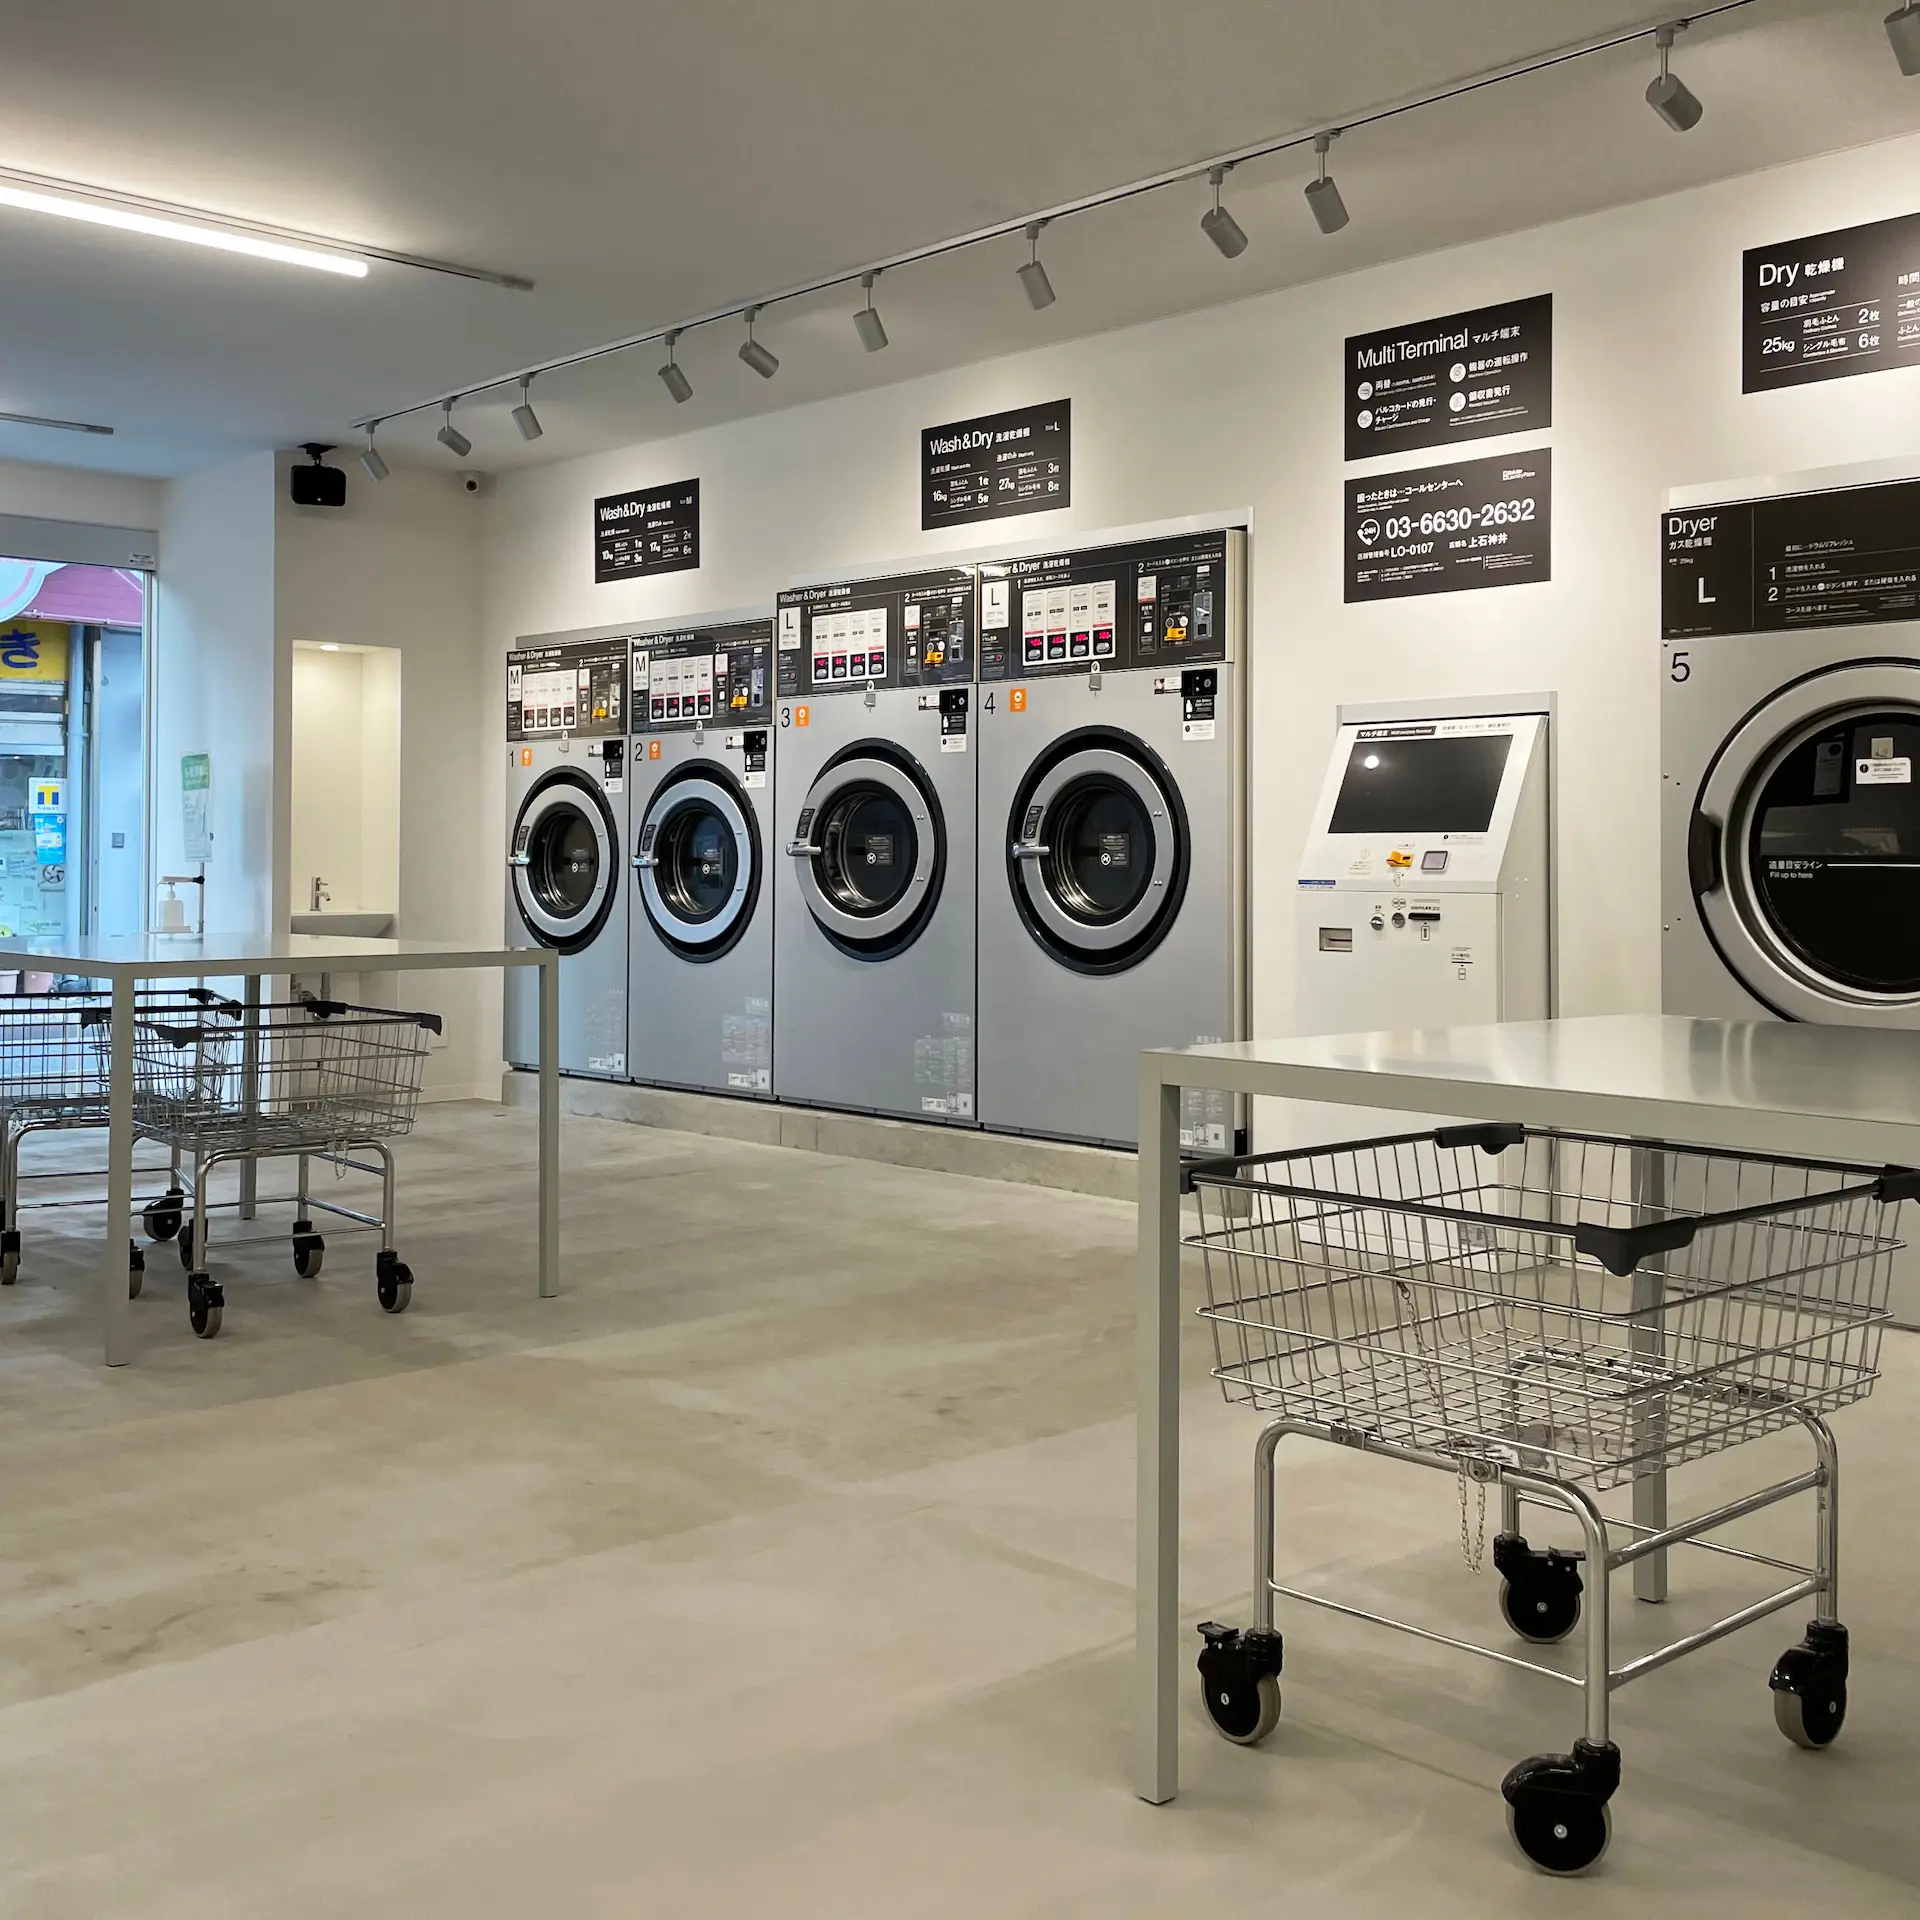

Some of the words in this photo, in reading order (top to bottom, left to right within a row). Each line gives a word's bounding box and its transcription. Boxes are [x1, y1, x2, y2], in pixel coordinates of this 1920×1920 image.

[1760, 263, 1800, 287] Dry
[1804, 257, 1845, 277] 乾燥機
[1760, 295, 1808, 313] 容量の目安
[1357, 348, 1396, 370] Multi
[1397, 328, 1468, 360] Terminal
[1472, 326, 1520, 344] マルチ端末
[1762, 336, 1795, 354] 25kg
[1468, 385, 1510, 402] 領収書発行
[1054, 422, 1060, 431] L
[1376, 412, 1399, 425] チャージ
[999, 478, 1015, 490] 27kg
[932, 490, 947, 502] 16kg
[1386, 498, 1536, 539] 03-6630-2632
[1668, 516, 1717, 537] Dryer
[1364, 527, 1376, 535] 24H
[1468, 532, 1508, 548] 上石神井
[1669, 536, 1712, 550] ガス乾燥機
[1391, 542, 1434, 558] LO-0107
[1138, 563, 1144, 573] 2
[1769, 567, 1776, 580] 1
[1017, 579, 1021, 589] 1
[1698, 577, 1716, 603] L
[904, 593, 910, 603] 2
[991, 588, 1000, 606] L
[1768, 587, 1778, 601] 2
[786, 613, 793, 629] L
[0, 628, 40, 668] き
[715, 643, 720, 652] 2
[579, 659, 583, 667] 2
[636, 656, 645, 672] M
[1671, 652, 1690, 683] 5
[510, 670, 519, 684] M
[984, 692, 996, 714] 4
[781, 707, 790, 728] 3
[509, 751, 515, 767] 1
[634, 743, 643, 762] 2
